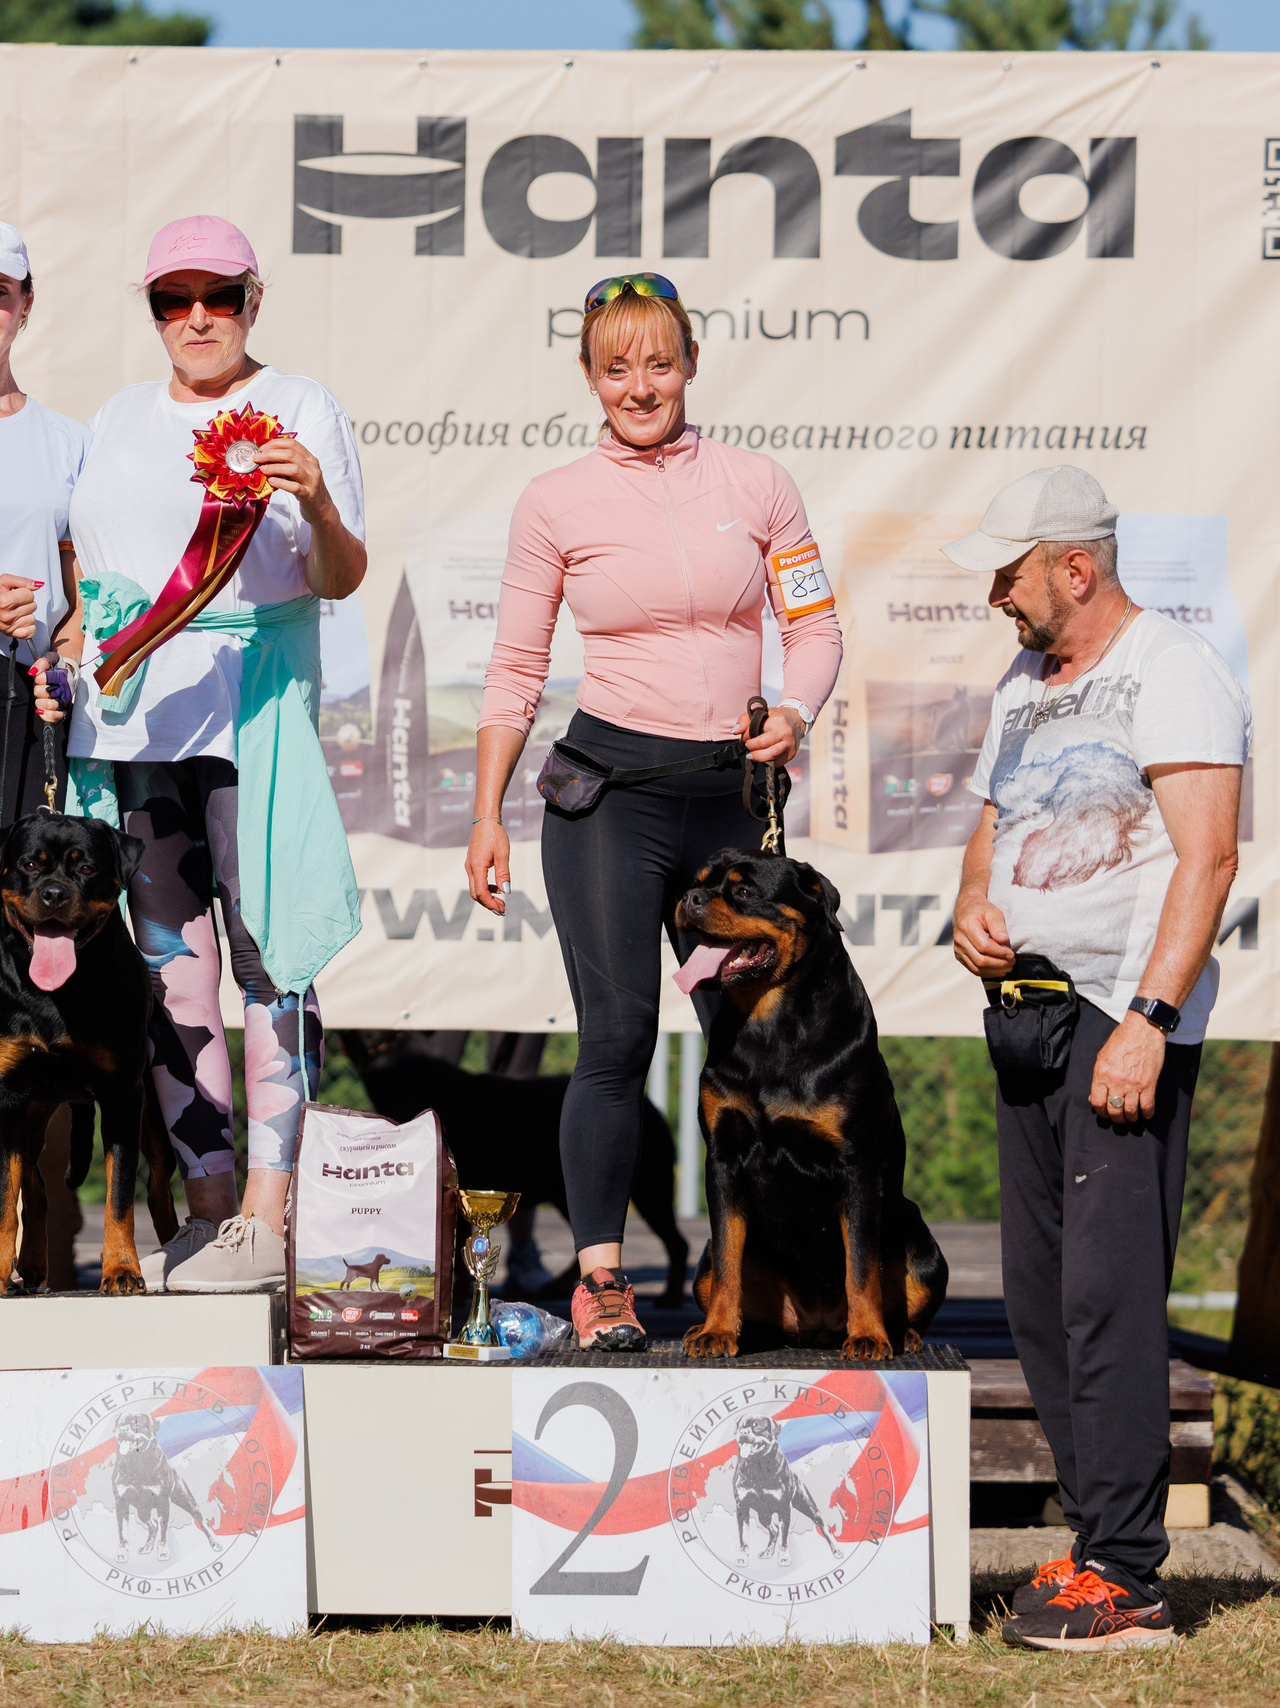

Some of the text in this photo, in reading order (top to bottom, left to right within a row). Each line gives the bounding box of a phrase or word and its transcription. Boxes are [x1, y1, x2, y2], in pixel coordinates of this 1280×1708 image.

[292, 108, 1137, 262] Hanta
[548, 299, 870, 347] pmium
[950, 423, 1148, 450] питания
[791, 565, 820, 598] 81
[887, 602, 993, 623] Hanta
[1157, 603, 1213, 624] nta
[392, 698, 412, 828] Hanta
[831, 698, 849, 831] Hanta
[322, 1161, 415, 1180] Hanta
[351, 1207, 382, 1215] PUPPY
[51, 1379, 270, 1542] РОТВЕЙЛЕР КЛУБ РОССИИ
[671, 1383, 892, 1547] РОТВЕЙЛЕР КЛУБ РОССИИ
[528, 1380, 651, 1596] 2
[104, 1560, 225, 1596] РКФ-НКПР
[724, 1567, 847, 1602] РКФ-НКПР
